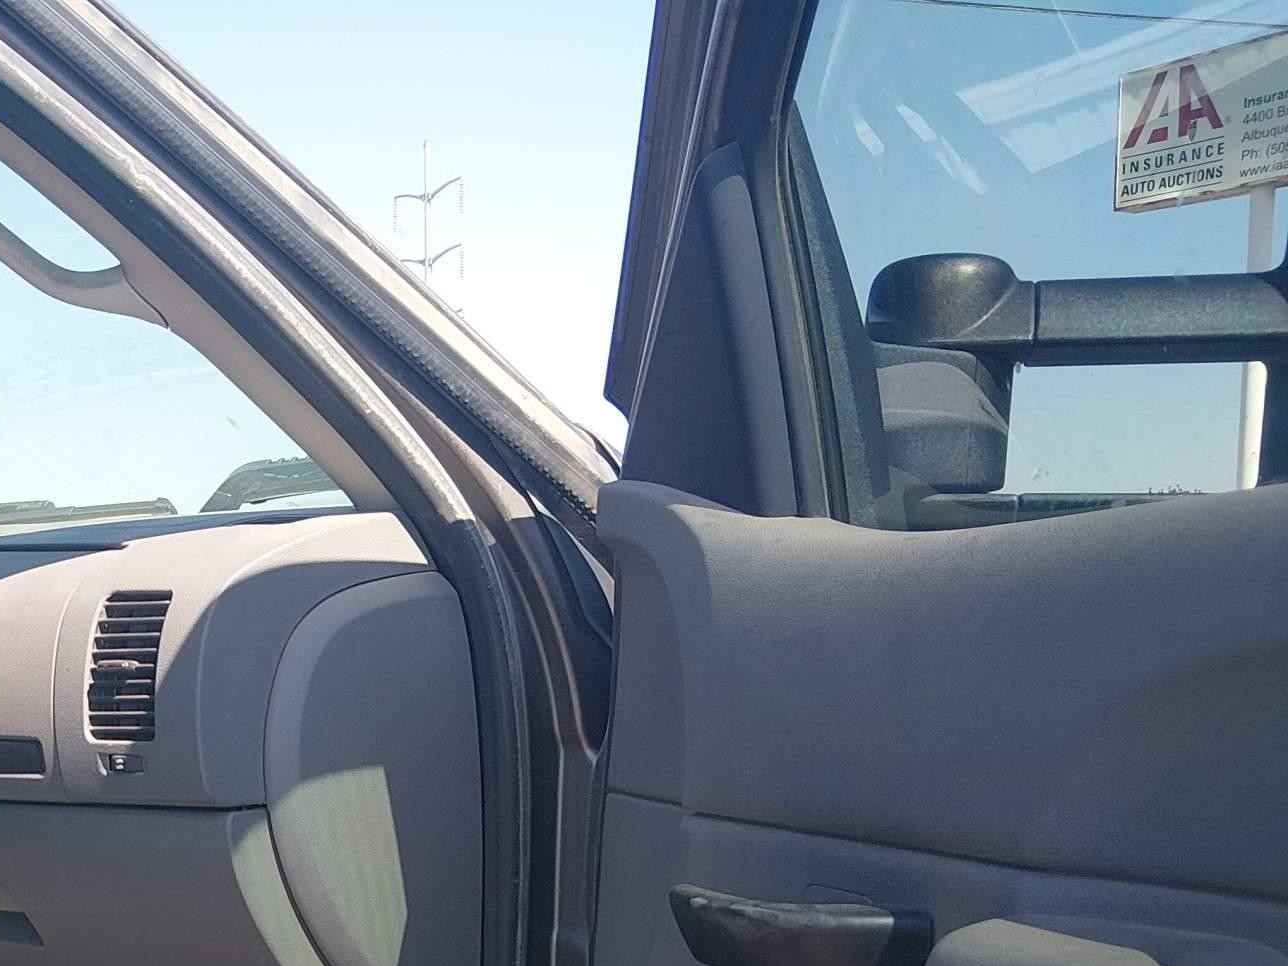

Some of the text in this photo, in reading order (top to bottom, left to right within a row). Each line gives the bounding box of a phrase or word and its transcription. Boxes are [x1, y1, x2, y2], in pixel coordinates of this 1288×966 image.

[1243, 108, 1273, 124] 4400
[1122, 142, 1225, 175] INSURANCE
[1121, 165, 1224, 198] AUTO AUCTIONS
